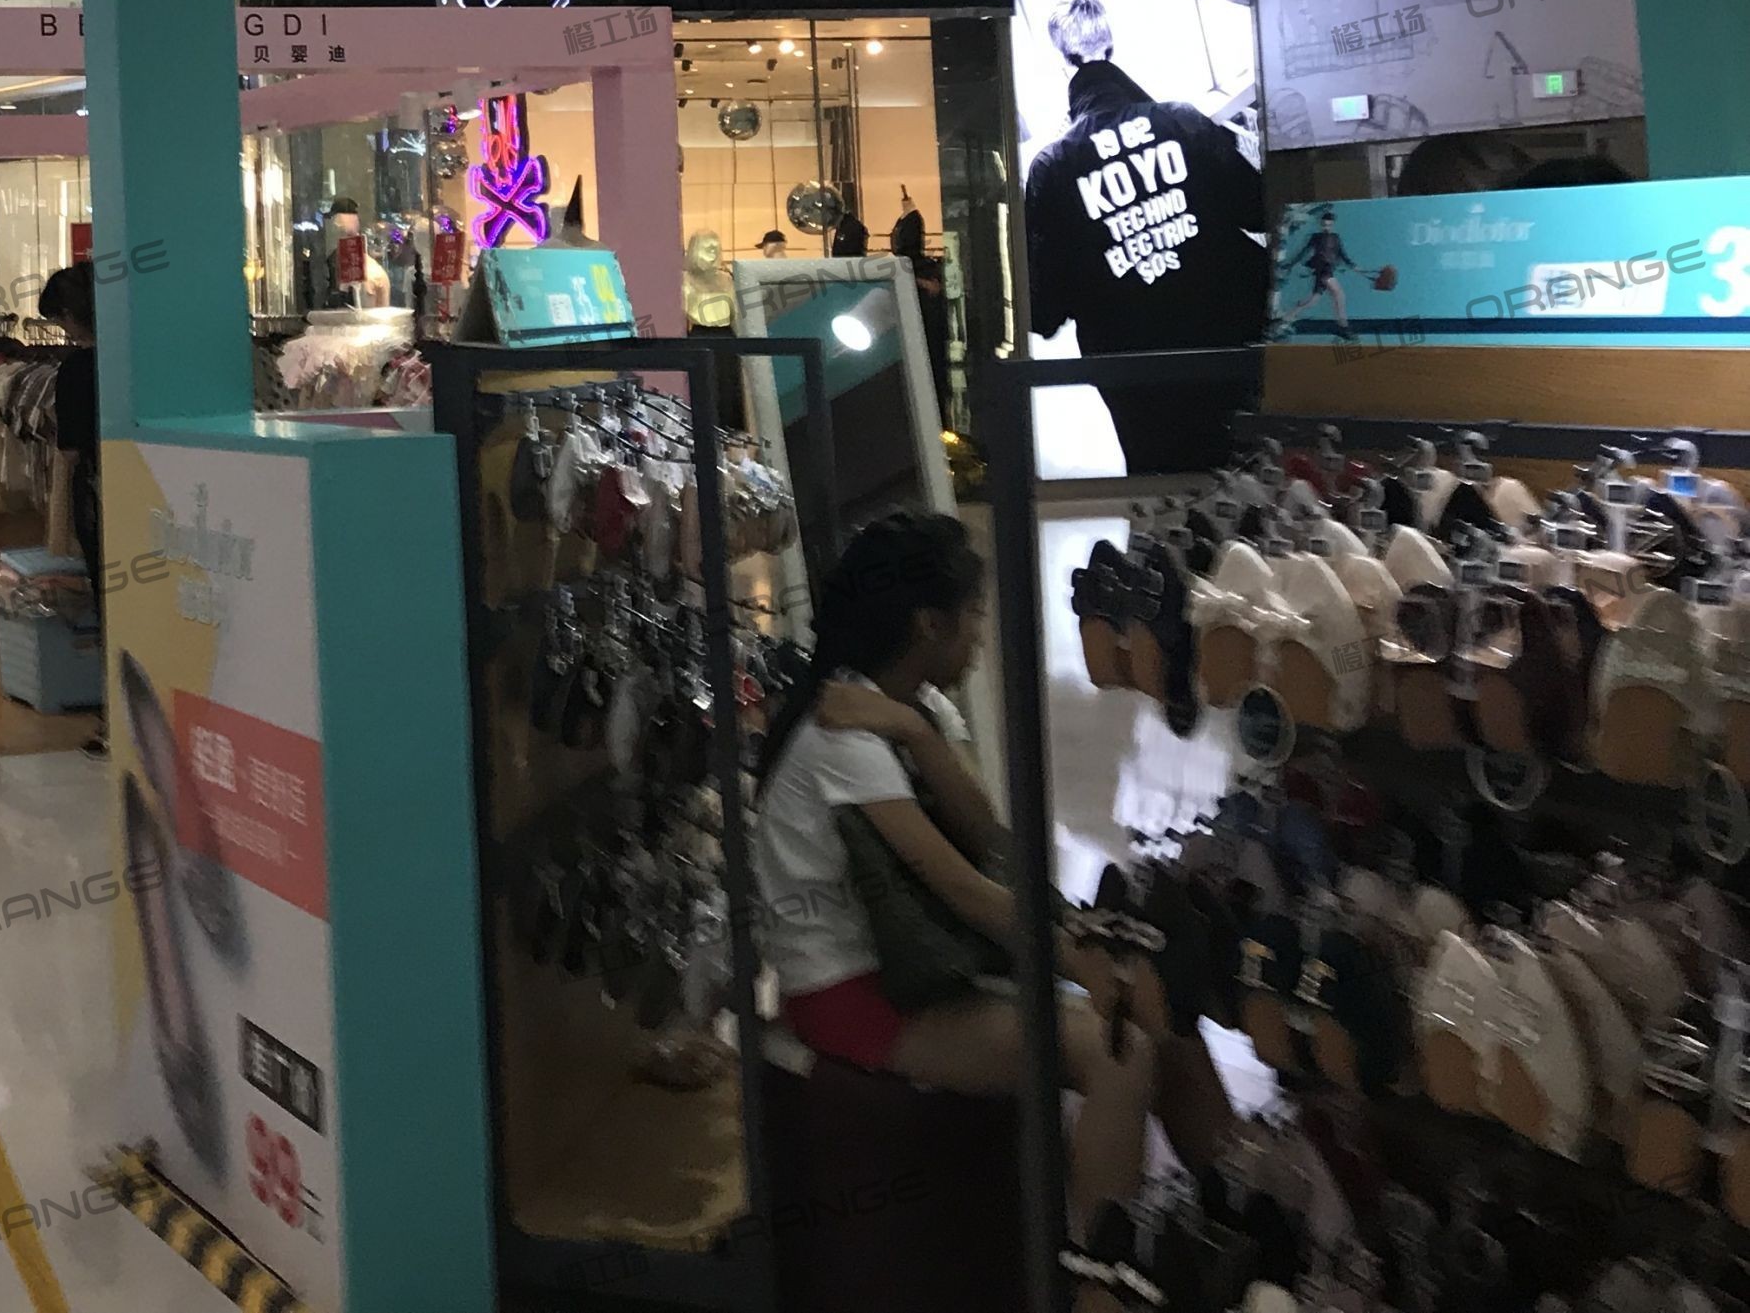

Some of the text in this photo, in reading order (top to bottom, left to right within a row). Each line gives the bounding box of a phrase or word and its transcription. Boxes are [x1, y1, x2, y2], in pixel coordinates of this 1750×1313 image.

[254, 45, 346, 64] 贝婴迪
[1076, 140, 1188, 220] KOYO
[1103, 188, 1188, 242] TECHNO
[1103, 213, 1199, 278] ELECTRIC
[1135, 250, 1181, 285] SOS
